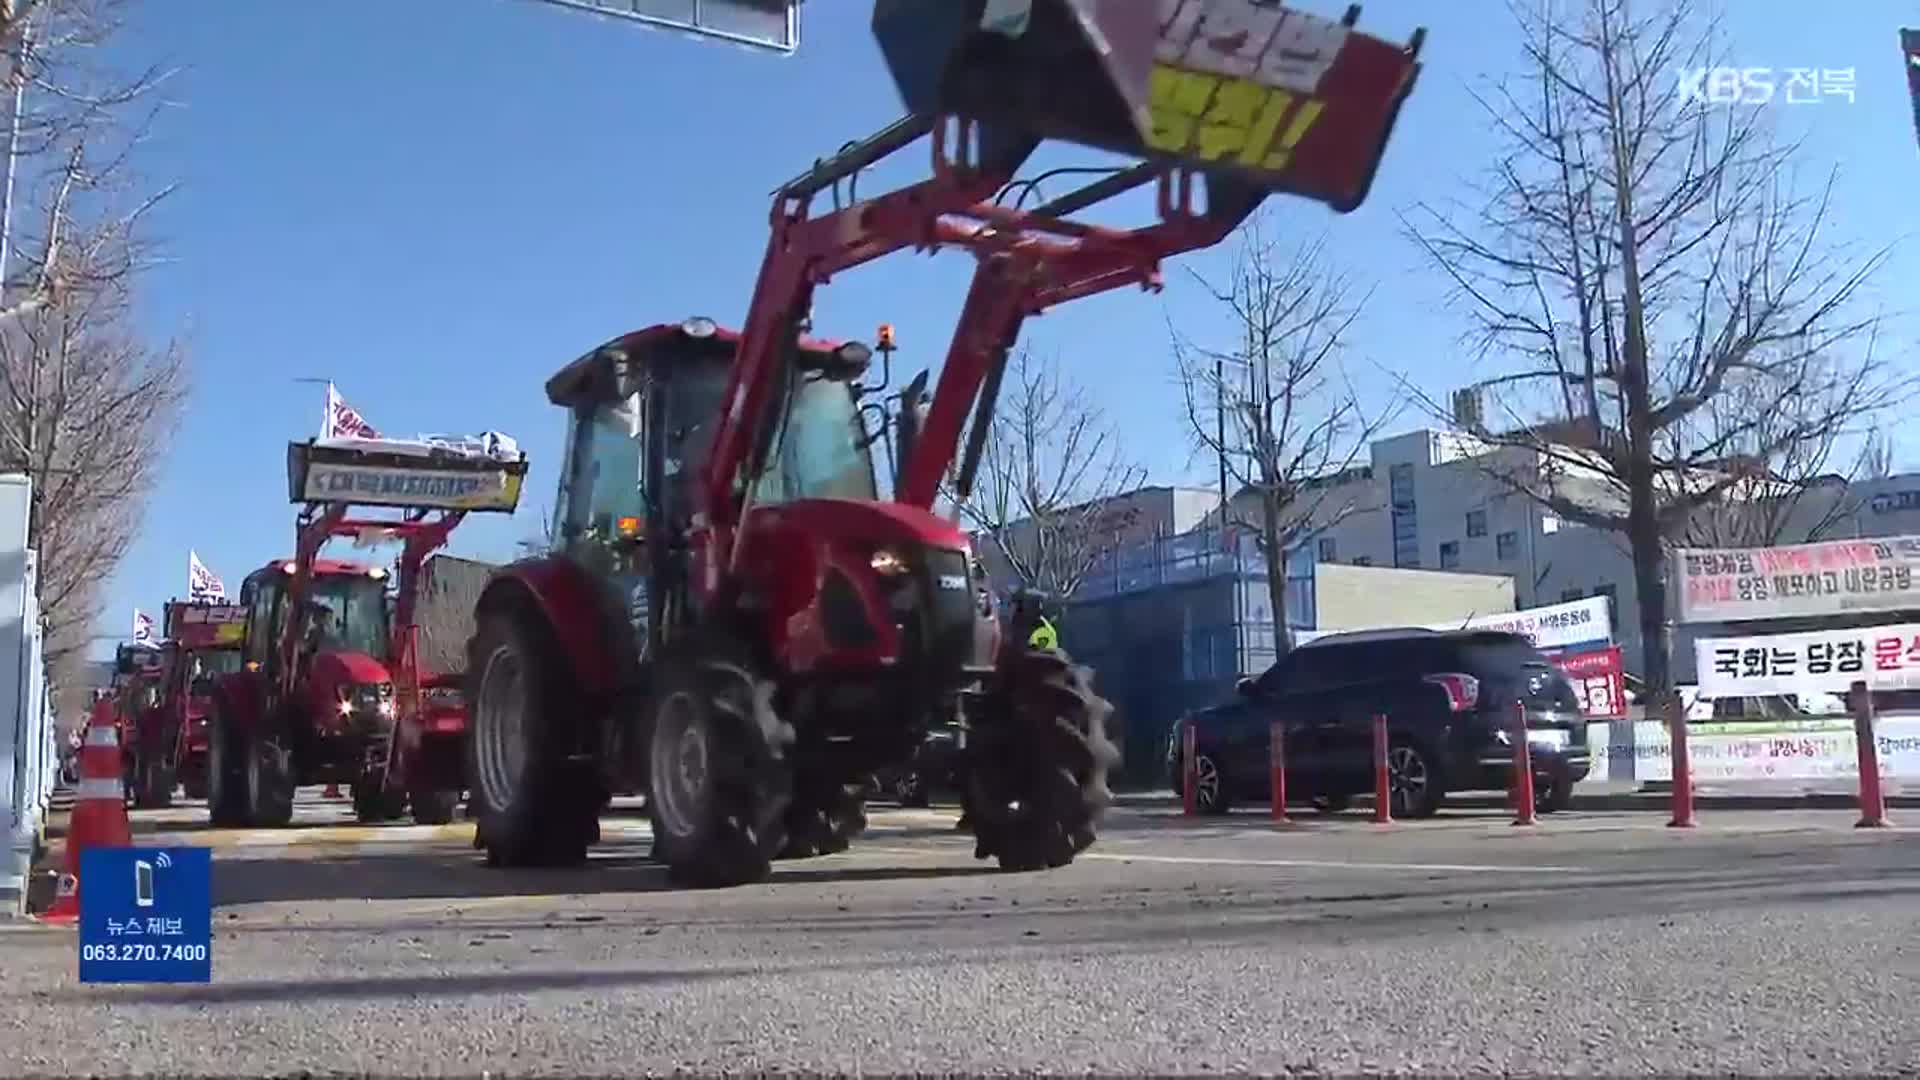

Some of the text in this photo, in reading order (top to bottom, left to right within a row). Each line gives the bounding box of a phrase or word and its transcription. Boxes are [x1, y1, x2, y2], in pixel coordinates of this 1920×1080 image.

[1737, 574, 1768, 600] 당장
[1714, 647, 1797, 678] 국회는
[1807, 640, 1866, 674] 당장
